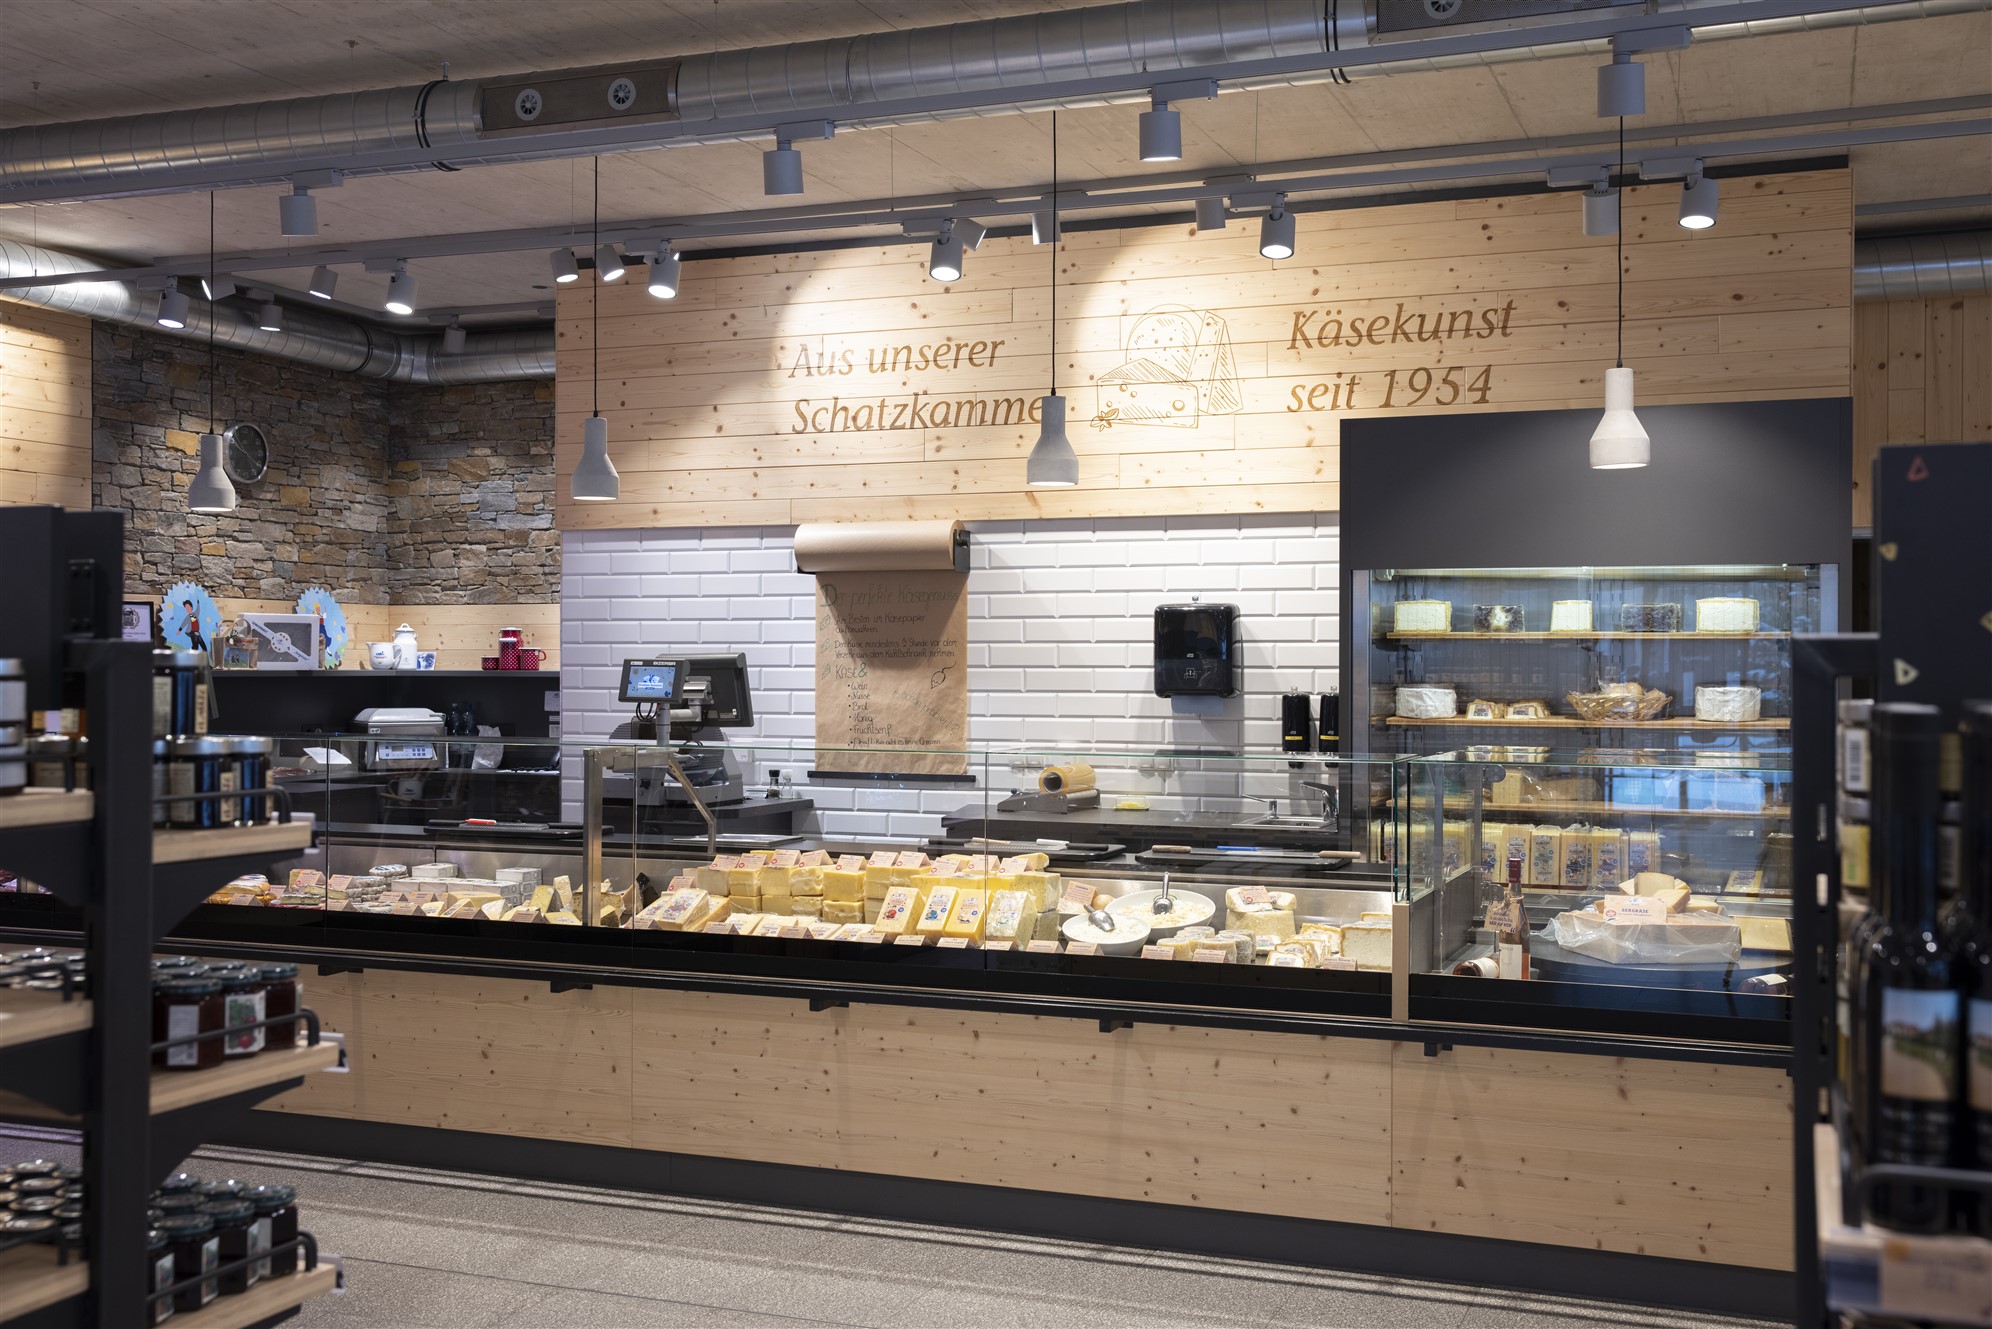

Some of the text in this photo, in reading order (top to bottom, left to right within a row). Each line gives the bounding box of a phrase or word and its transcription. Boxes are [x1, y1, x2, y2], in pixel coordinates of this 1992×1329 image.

[1287, 299, 1517, 350] Käsekunst
[788, 336, 1005, 378] Aus unserer
[1287, 364, 1492, 412] seit 1954
[791, 392, 1043, 434] Schatzkamme
[858, 662, 868, 678] &
